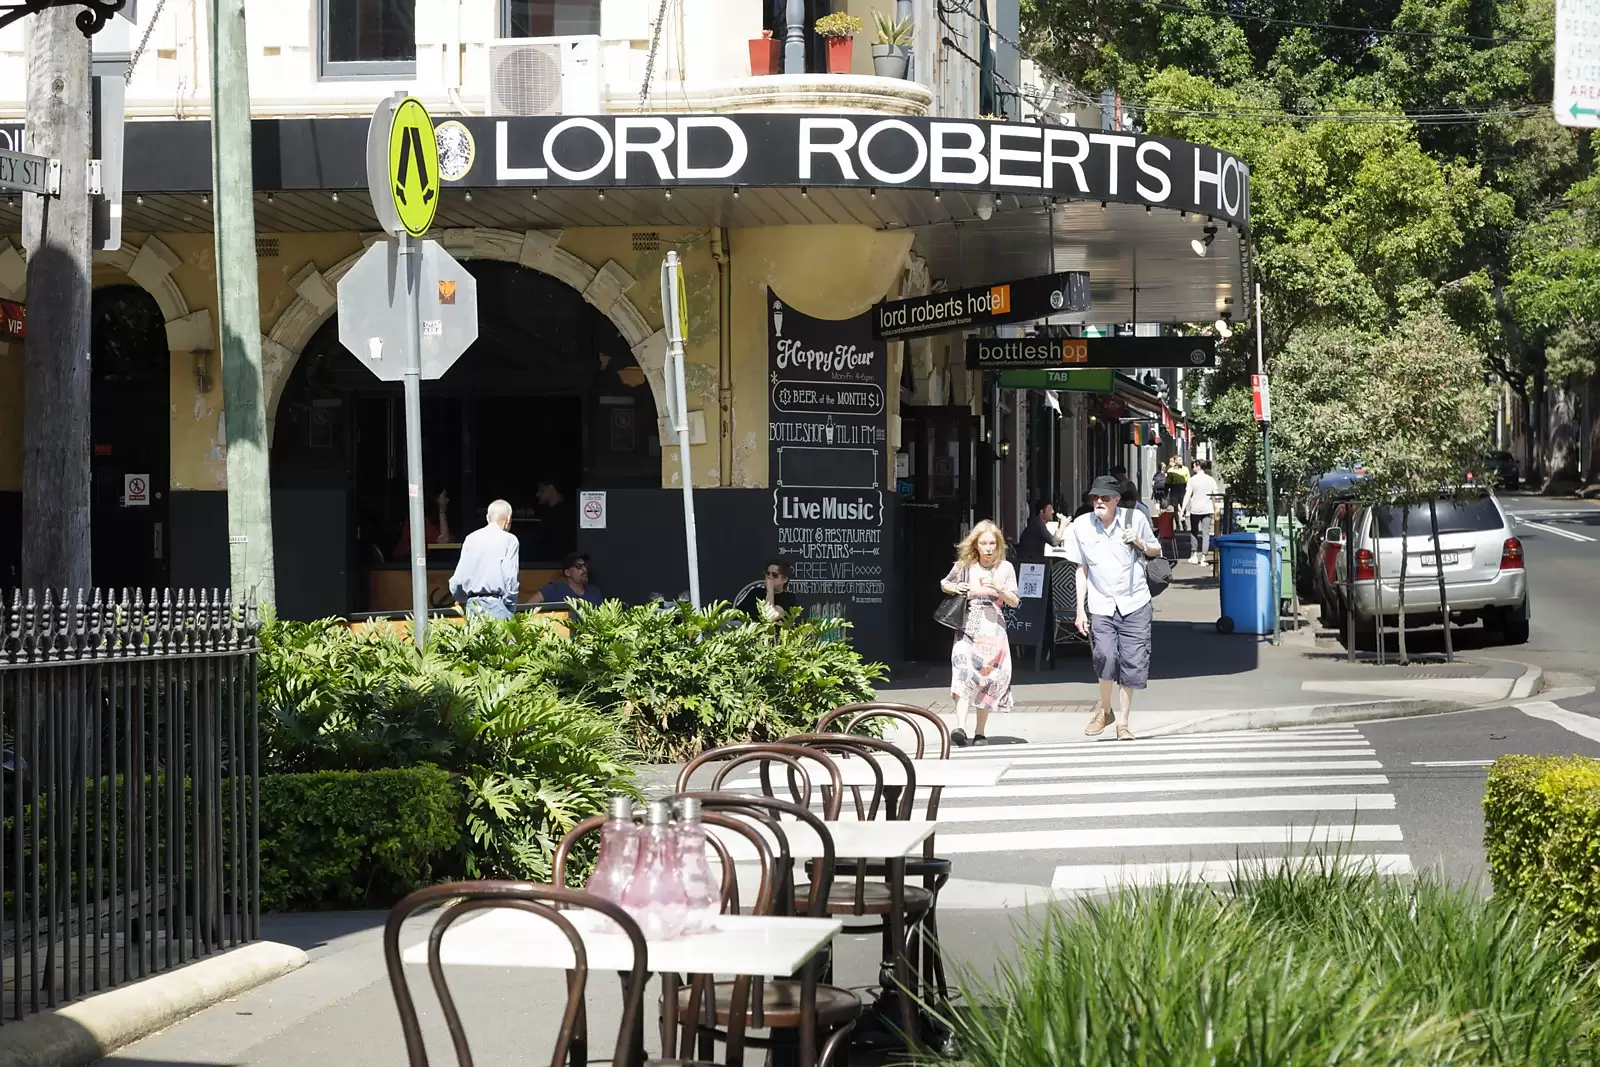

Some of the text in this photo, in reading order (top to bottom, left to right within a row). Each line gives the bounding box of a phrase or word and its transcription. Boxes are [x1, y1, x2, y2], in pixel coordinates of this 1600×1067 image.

[23, 159, 40, 185] ST
[496, 116, 1250, 219] LORD ROBERTS HOT
[880, 287, 1004, 328] lord roberts hotel
[8, 318, 23, 334] VIP
[776, 339, 874, 372] Happy Hour
[979, 341, 1087, 363] bottleshop
[1047, 372, 1068, 382] TAB
[793, 390, 819, 404] BEER
[837, 391, 867, 406] MONTH
[769, 422, 824, 443] BOTTLESHOP
[861, 425, 876, 444] PM
[782, 496, 874, 520] Live Music
[778, 527, 881, 543] BALCONY & RESTAURANT
[803, 543, 850, 559] UPSTAIRS
[795, 561, 855, 579] FREE WIFI
